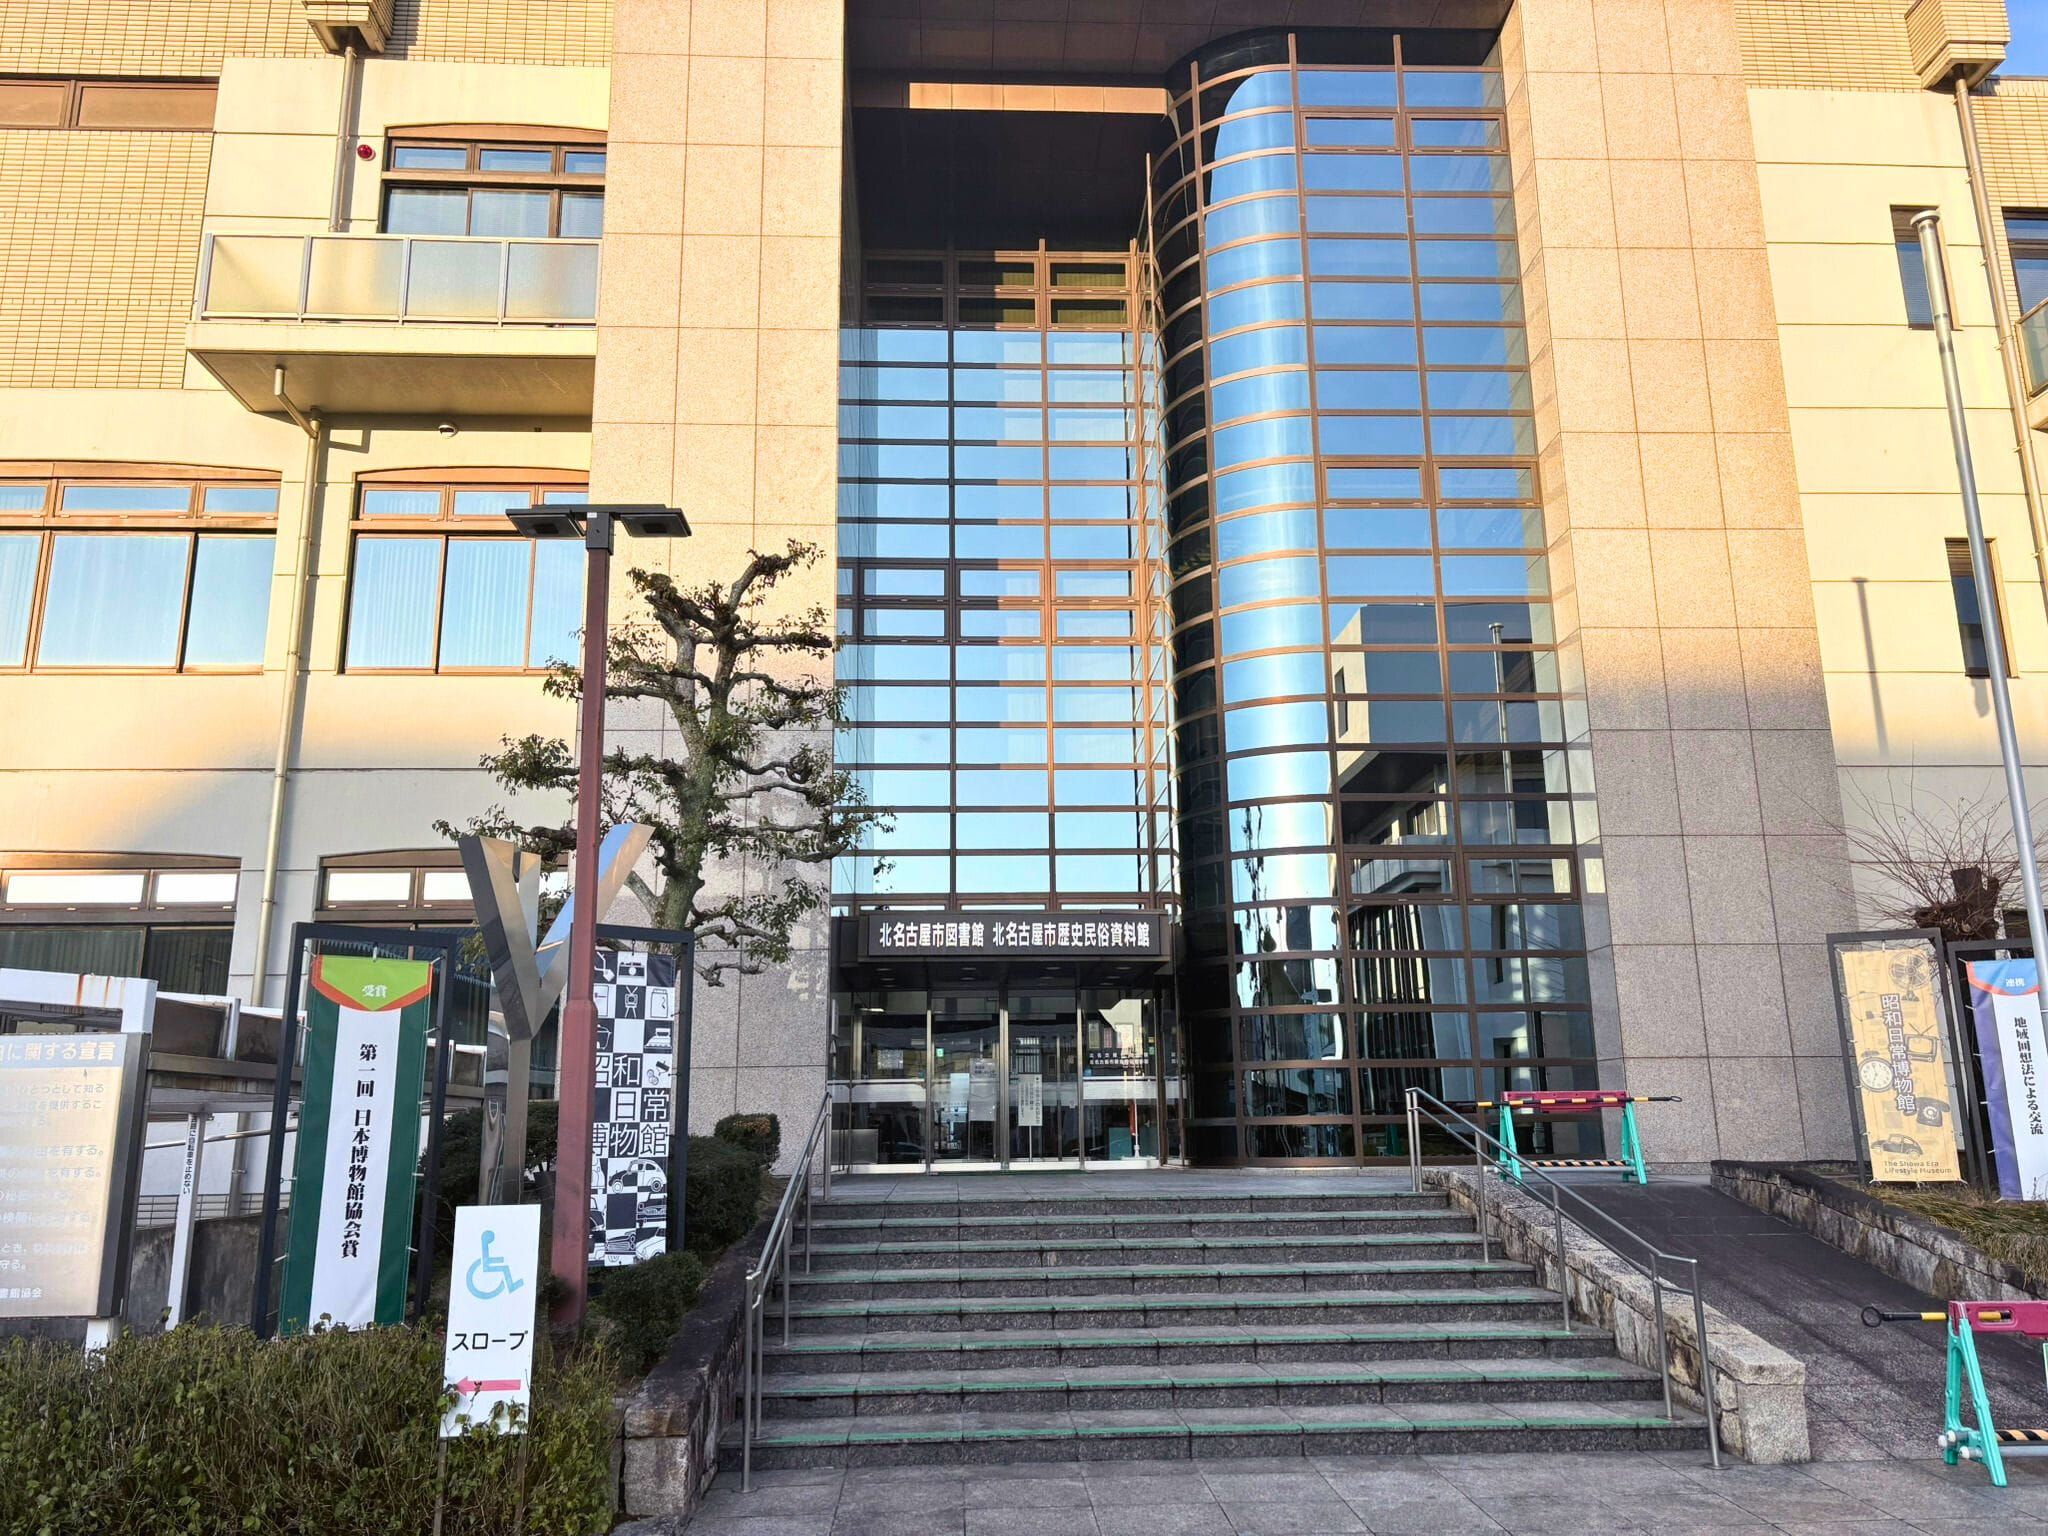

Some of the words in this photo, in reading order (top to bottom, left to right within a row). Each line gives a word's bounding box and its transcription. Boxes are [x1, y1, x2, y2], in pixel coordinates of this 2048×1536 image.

[879, 922, 984, 947] 北名古屋市図書館
[992, 922, 1150, 947] 北名古屋市歴史民俗資料館
[362, 984, 387, 998] 受賞
[2005, 978, 2025, 987] 連携
[0, 1041, 116, 1061] に関する宣言
[1881, 994, 1915, 1113] 昭和日常博物館
[357, 1043, 377, 1097] 第一回
[2014, 1016, 2043, 1135] 地域回想法による交流
[616, 1089, 669, 1121] 日常
[341, 1109, 371, 1258] 日本博物館協会賞
[452, 1330, 529, 1351] スロープ
